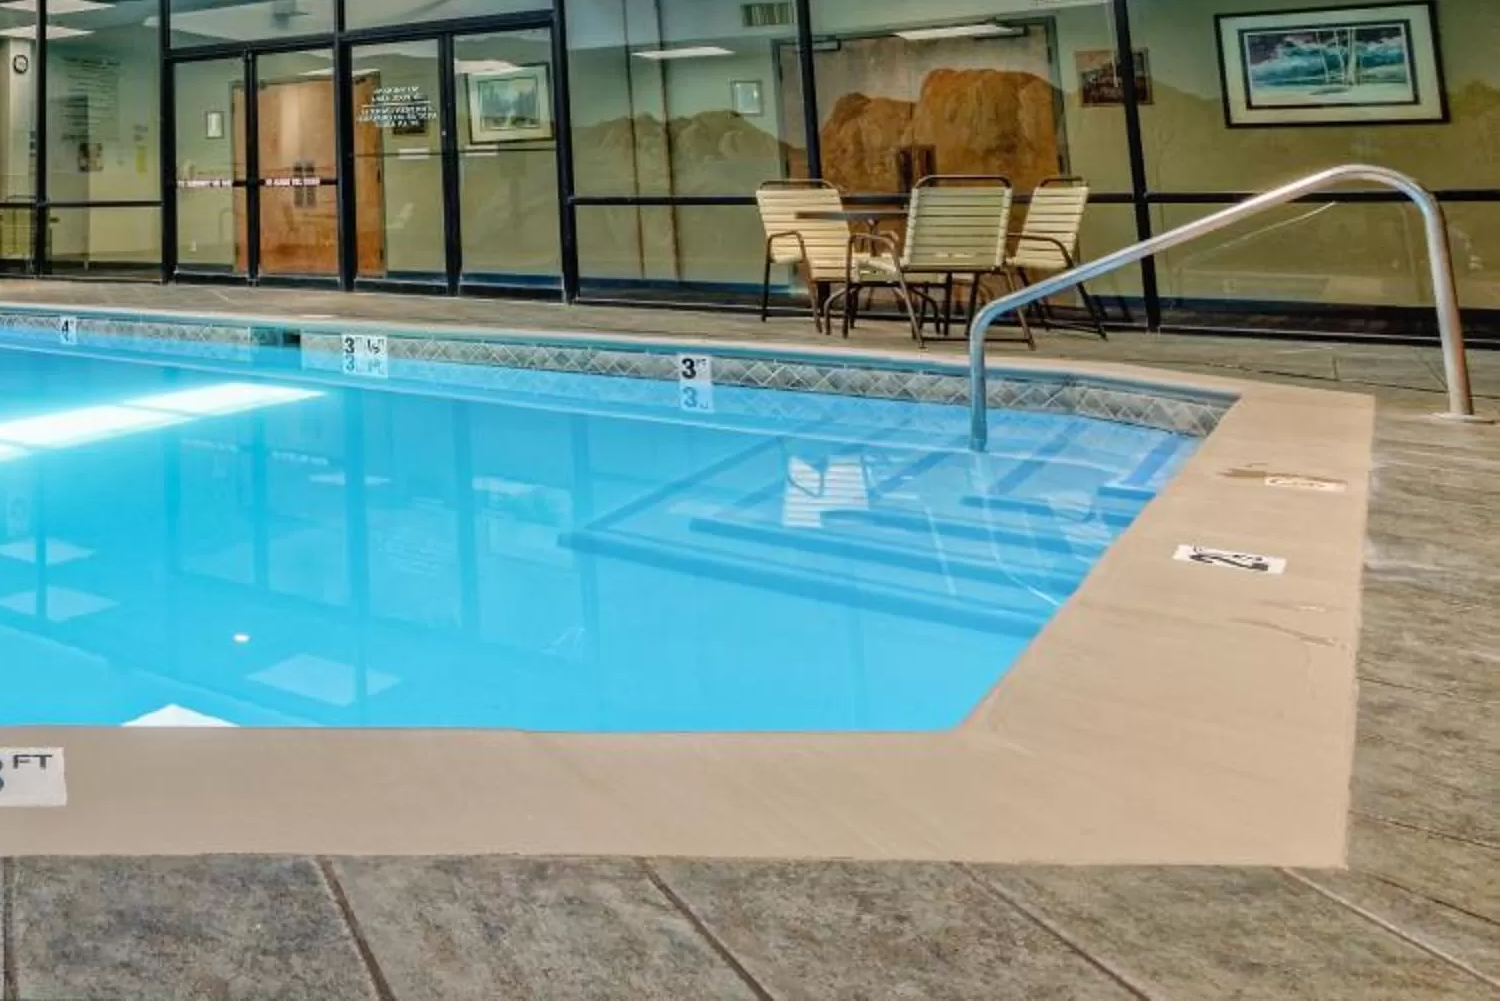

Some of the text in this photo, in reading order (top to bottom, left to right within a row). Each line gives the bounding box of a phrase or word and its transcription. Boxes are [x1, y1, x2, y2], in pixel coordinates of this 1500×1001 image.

[344, 337, 355, 354] 3
[681, 358, 697, 379] 3
[12, 754, 52, 770] FT
